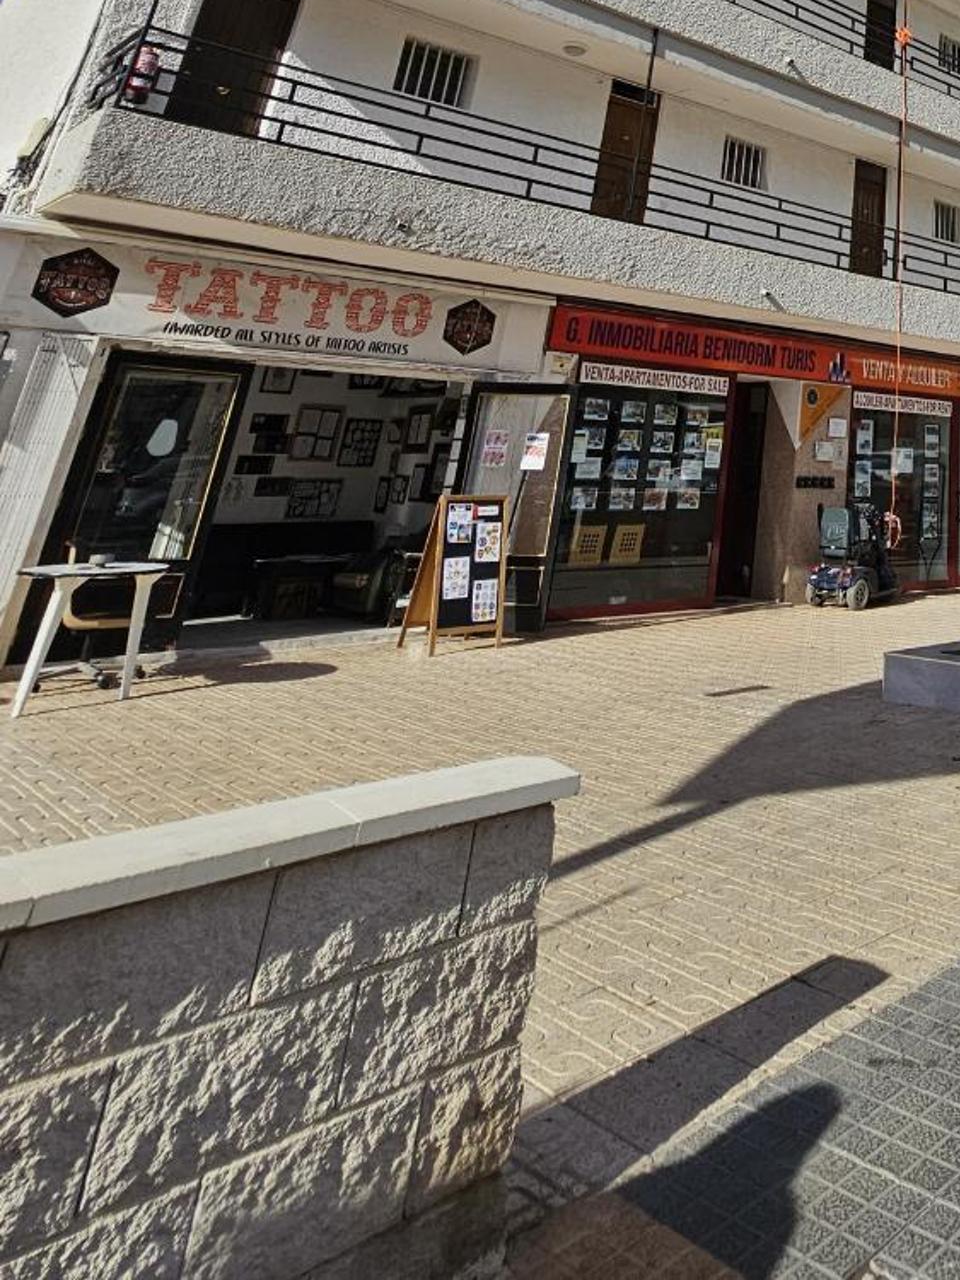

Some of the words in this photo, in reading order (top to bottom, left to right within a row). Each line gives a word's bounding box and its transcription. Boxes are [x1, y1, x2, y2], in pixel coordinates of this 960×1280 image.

[144, 257, 433, 337] TATTOO
[163, 320, 231, 339] AWARDED
[235, 329, 254, 342] ALL
[260, 330, 301, 347] STYLES
[305, 334, 322, 349] OF
[325, 336, 365, 352] TATTOO
[368, 340, 409, 356] ARTISTS
[565, 317, 582, 343] G.
[588, 318, 700, 358] INMOBILIARIA
[703, 334, 776, 369] BENIDORM
[780, 347, 817, 372] TURIS
[707, 377, 729, 394] SALE
[862, 358, 896, 383] VENTA
